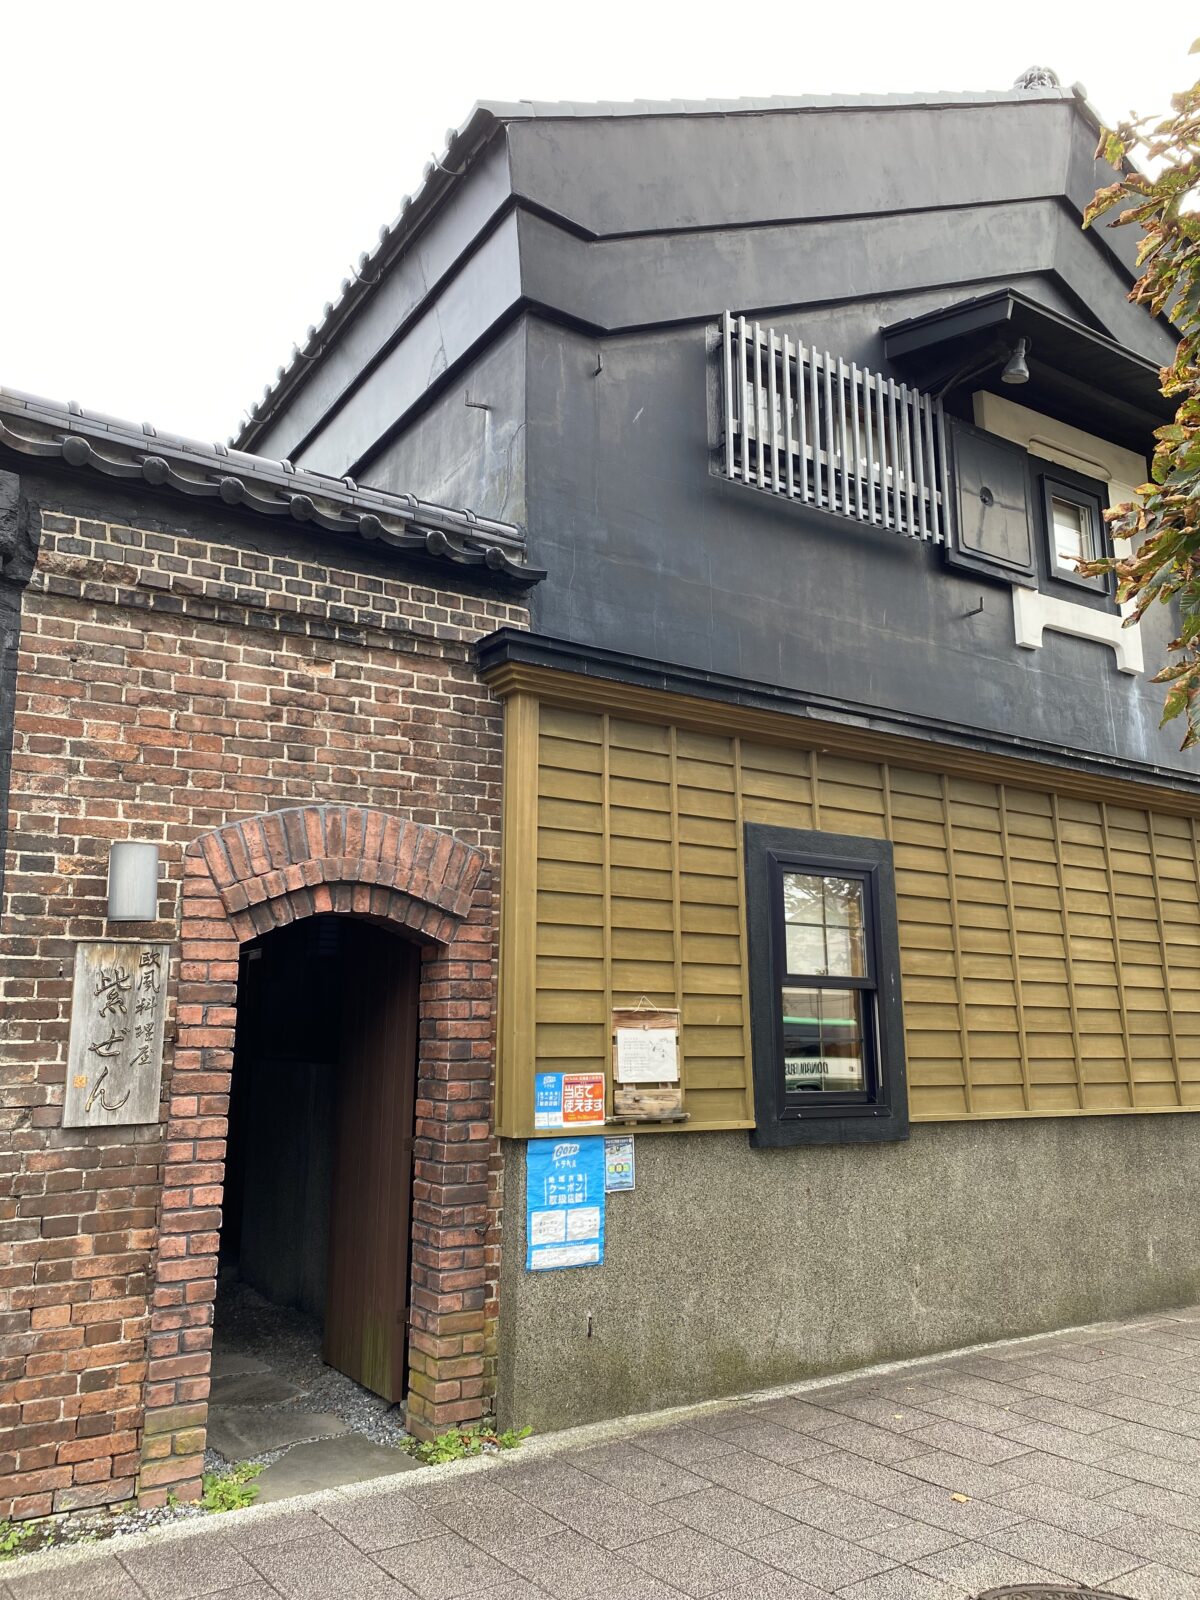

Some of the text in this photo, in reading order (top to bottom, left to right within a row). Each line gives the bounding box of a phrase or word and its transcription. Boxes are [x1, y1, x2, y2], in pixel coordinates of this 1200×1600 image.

[129, 951, 161, 1067] 欧風料理屋
[85, 966, 132, 1112] 紫ぜん
[564, 1084, 594, 1099] 当店で
[564, 1098, 603, 1113] 使えます
[555, 1159, 577, 1169] トラベル
[548, 1182, 583, 1194] クーポン
